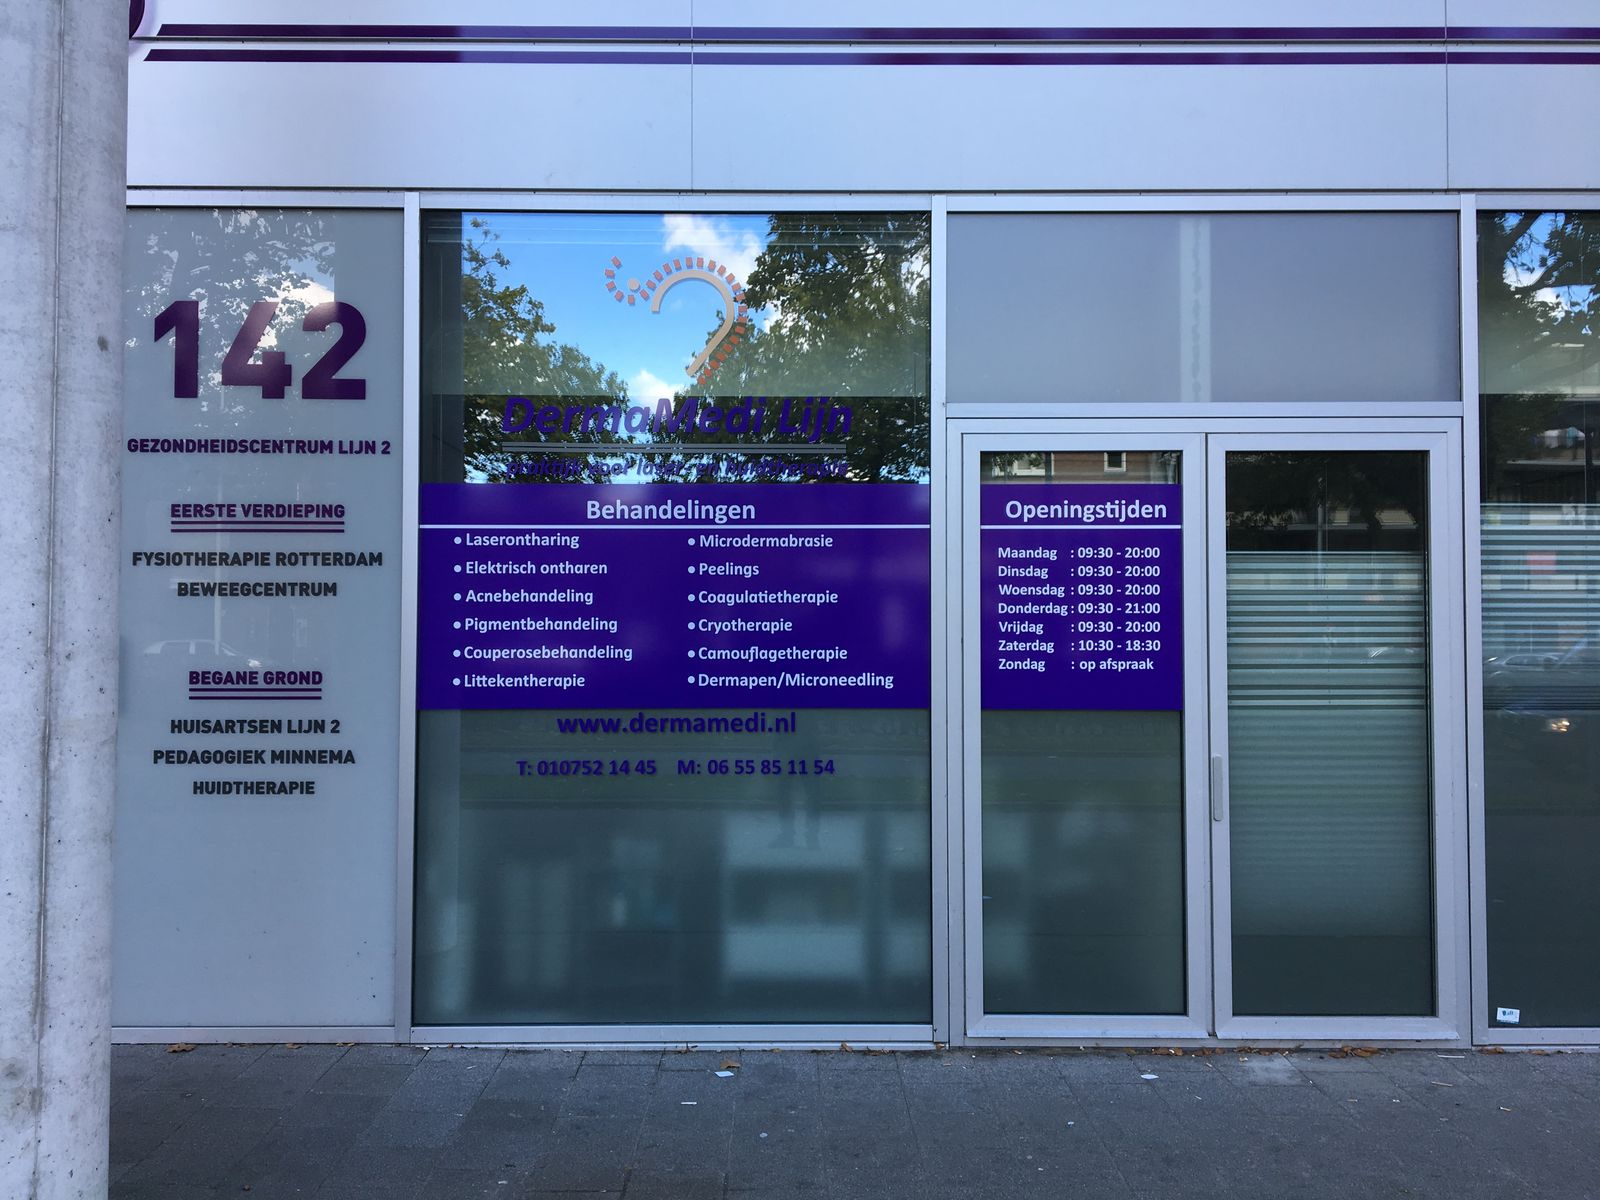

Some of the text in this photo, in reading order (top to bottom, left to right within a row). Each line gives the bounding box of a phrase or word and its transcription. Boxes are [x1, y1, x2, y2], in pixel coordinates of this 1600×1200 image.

[154, 300, 366, 400] 142
[503, 396, 852, 443] DermaMedi Lijn
[128, 439, 391, 455] GEZONDHEIDSCENTRUM LIJN 2
[505, 457, 582, 479] praktijk
[587, 462, 633, 475] voor
[696, 462, 719, 475] en
[725, 458, 850, 479] huidtherapie
[171, 504, 345, 518] EERSTE VERDIEPING
[586, 500, 755, 523] Behandelingen
[1006, 500, 1166, 522] Openingstijden
[465, 533, 580, 549] Laserontharing
[699, 534, 833, 548] Microdermabrasie
[133, 552, 383, 567] FYSIOTHERAPIE ROTTERDAM
[998, 547, 1057, 560] Maandag
[1078, 548, 1113, 558] 09:30
[1125, 548, 1160, 558] 20:00
[465, 560, 608, 575] Elektrisch ontharen
[699, 562, 759, 577] Peelings
[998, 566, 1048, 579] Dinsdag
[1078, 566, 1113, 576] 09:30
[1125, 566, 1160, 576] 20:00
[177, 582, 337, 596] BEWEEGCENTRUM
[999, 584, 1065, 597] Woensdag
[1078, 584, 1113, 595] 09:30
[1125, 584, 1160, 595] 20:00
[465, 589, 593, 605] Acnebehandeling
[698, 590, 838, 606] Coagulatietherapie
[999, 603, 1068, 616] Donderdag
[1078, 603, 1113, 613] 09:30
[1125, 603, 1160, 613] 21:00
[465, 617, 617, 634] Pigmentbehandeling
[698, 618, 793, 634] Cryotherapie
[999, 621, 1043, 634] Vrijdag
[1078, 622, 1113, 632] 09:30
[1125, 622, 1160, 632] 20:00
[464, 645, 633, 662] Couperosebehandeling
[698, 646, 848, 662] Camouflagetherapie
[999, 640, 1054, 653] Zaterdag
[1078, 640, 1113, 650] 10:30
[1125, 640, 1160, 650] 18:30
[999, 658, 1045, 671] Zondag
[1079, 661, 1095, 671] op
[1100, 658, 1154, 672] afspraak
[189, 671, 323, 685] BEGANE GROND
[464, 674, 585, 690] Littekentherapie
[698, 673, 894, 690] Dermapen/Microneedling
[171, 719, 340, 734] HUISARTSEN LIJN 2
[557, 712, 796, 734] www.dermamedi.nl
[153, 750, 355, 765] PEDAGOGIEK MINNEMA
[516, 760, 531, 775] T:
[609, 760, 630, 775] 14
[635, 760, 656, 775] 45
[677, 760, 701, 775] M:
[707, 760, 729, 775] 06
[734, 760, 755, 775] 55
[760, 760, 781, 775] 85
[787, 760, 808, 775] 11
[814, 760, 835, 775] 54
[193, 780, 315, 795] HUIDTHERAPIE
